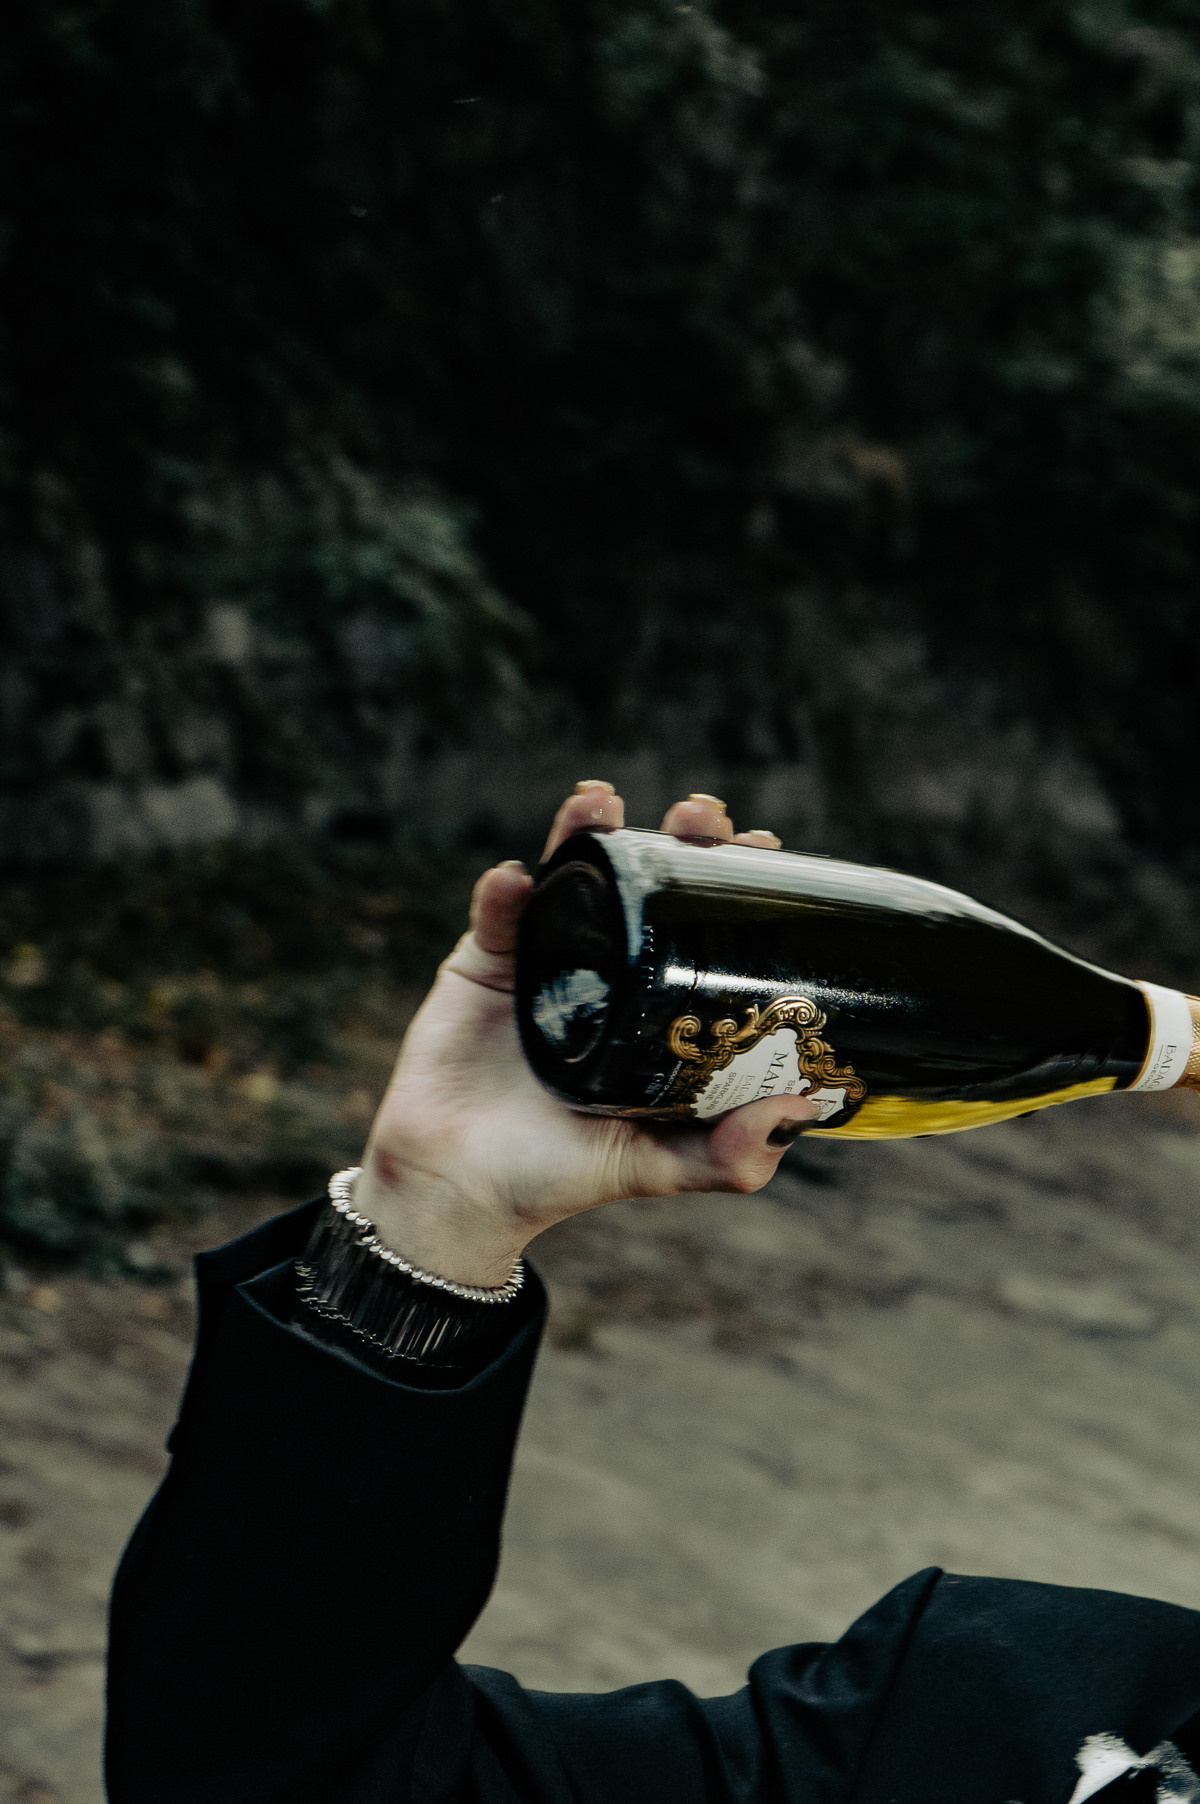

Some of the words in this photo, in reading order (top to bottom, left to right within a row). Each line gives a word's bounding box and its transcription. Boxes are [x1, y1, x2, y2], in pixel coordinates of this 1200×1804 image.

[752, 1050, 789, 1100] MAE
[783, 1080, 796, 1094] SE
[704, 1083, 722, 1100] WINE
[706, 1071, 737, 1110] SPARKLING
